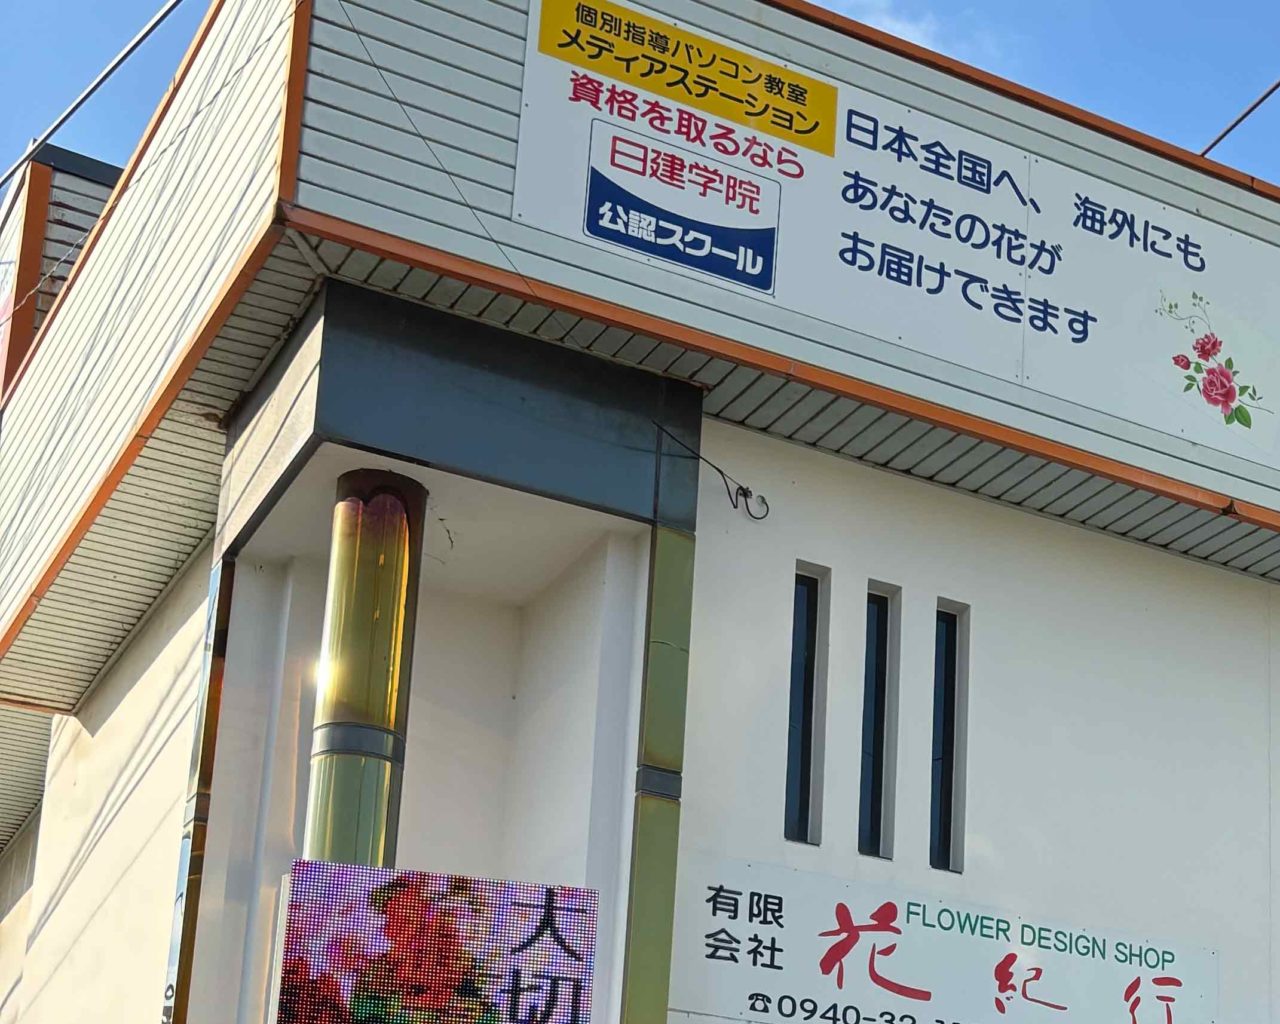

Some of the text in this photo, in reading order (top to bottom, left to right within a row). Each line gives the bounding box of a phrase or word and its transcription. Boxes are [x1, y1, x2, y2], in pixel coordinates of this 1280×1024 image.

[557, 28, 820, 136] メディアステーション
[574, 2, 809, 107] 個別指導パソコン教室
[567, 70, 805, 179] 資格を取るなら
[610, 135, 761, 215] 日建学院
[598, 201, 764, 276] 公認スクール
[841, 170, 1064, 276] あなたの花が
[844, 109, 1208, 273] 日本全国へ、 海外にも
[838, 230, 1099, 345] お届けできます
[703, 926, 785, 972] 会社
[704, 884, 785, 930] 有限
[905, 901, 1176, 971] FLOWER DESIGN SHOP
